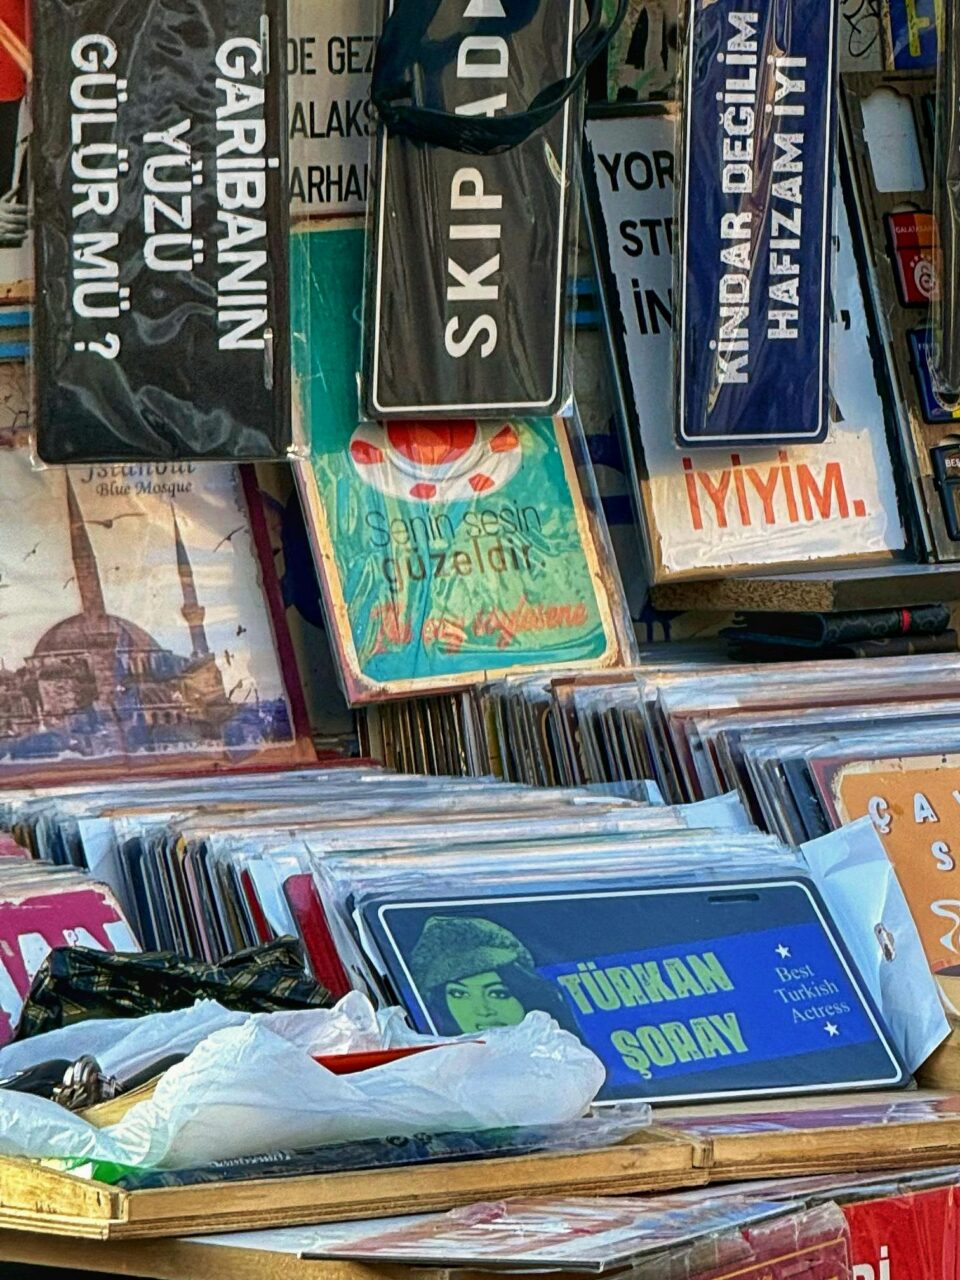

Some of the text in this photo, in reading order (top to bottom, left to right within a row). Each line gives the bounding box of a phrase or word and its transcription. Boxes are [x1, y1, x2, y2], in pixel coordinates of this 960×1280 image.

[70, 33, 129, 218] GÜLÜR
[142, 118, 204, 273] YÜZÜ
[215, 37, 279, 352] GARİBANIN
[289, 164, 369, 204] ARHA
[708, 11, 759, 386] KİNDAR DEĞİLİM
[765, 54, 806, 339] HAFIZAM İYİ
[444, 166, 503, 359] SKIP
[96, 480, 193, 499] Blue Mosque
[365, 499, 543, 548] Senin sesin
[556, 950, 735, 1016] TÜRKAN
[774, 977, 839, 1007] Turkish
[775, 962, 816, 985] Best
[790, 998, 851, 1024] Actress
[610, 1011, 750, 1081] ŞORAY
